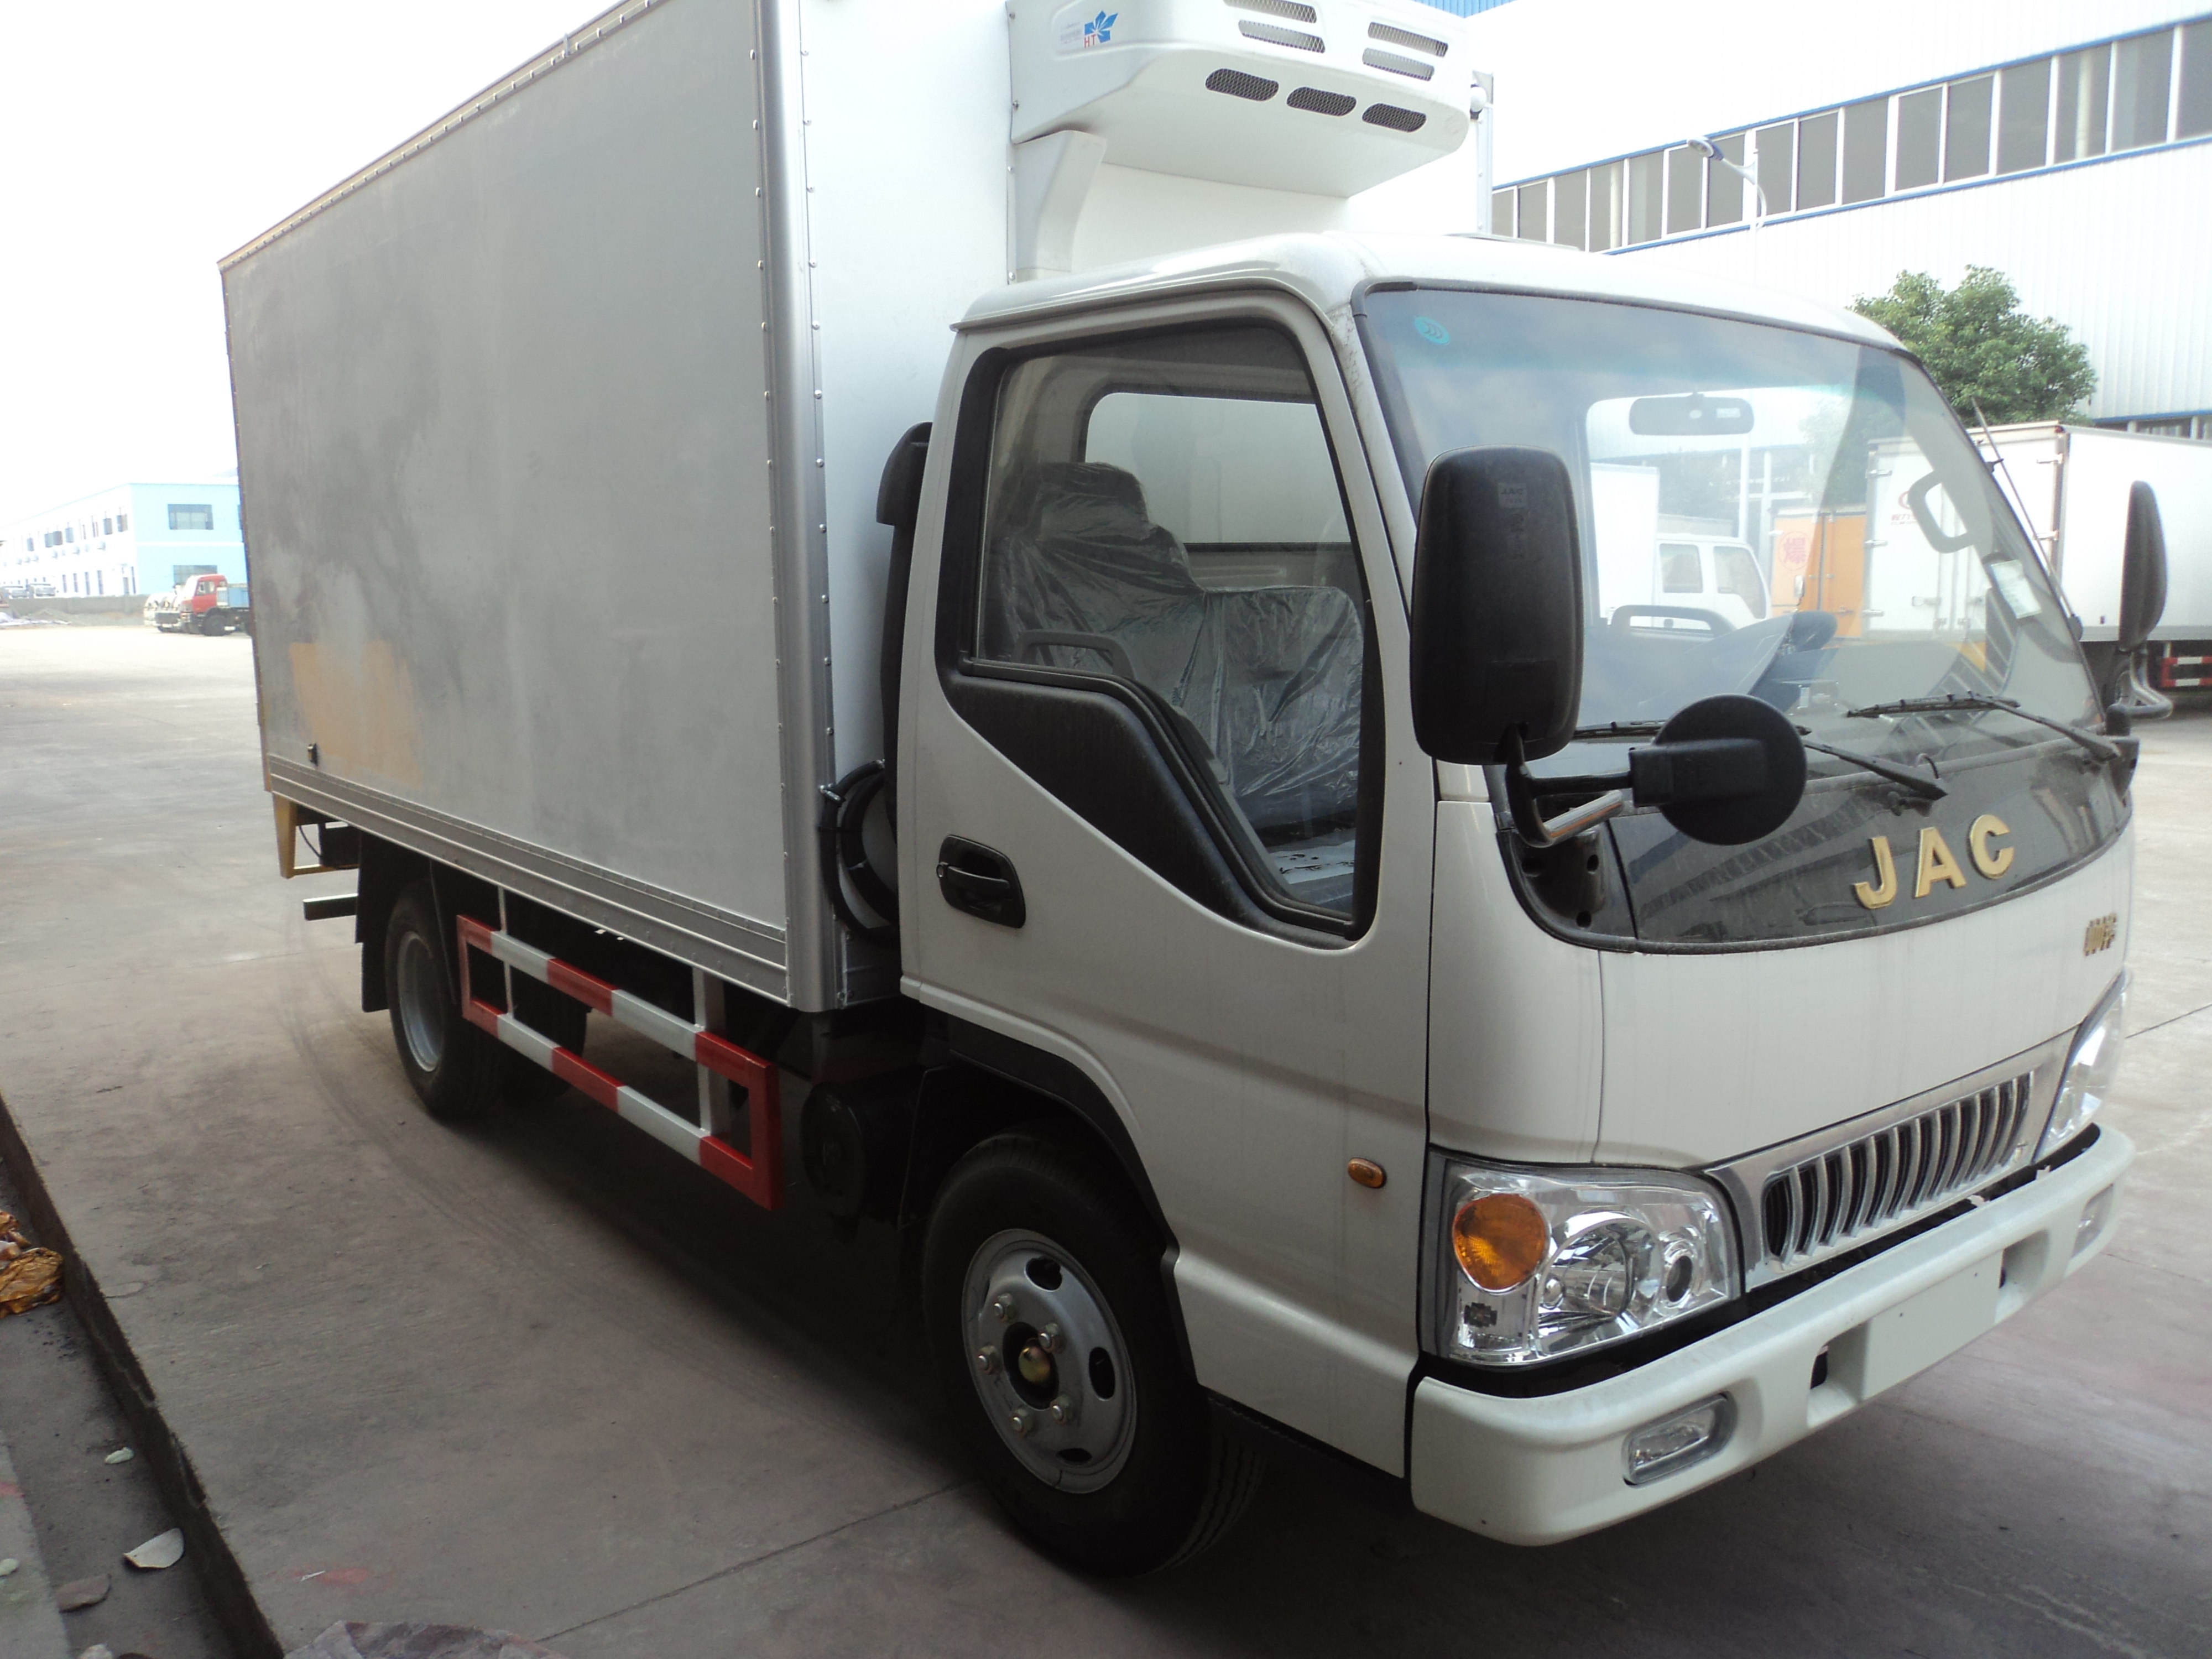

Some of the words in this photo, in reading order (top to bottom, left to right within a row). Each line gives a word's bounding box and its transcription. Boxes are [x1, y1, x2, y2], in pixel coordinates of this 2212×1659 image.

[1084, 34, 1097, 49] HT
[1783, 537, 1807, 564] 爆
[1853, 814, 2015, 909] JAC
